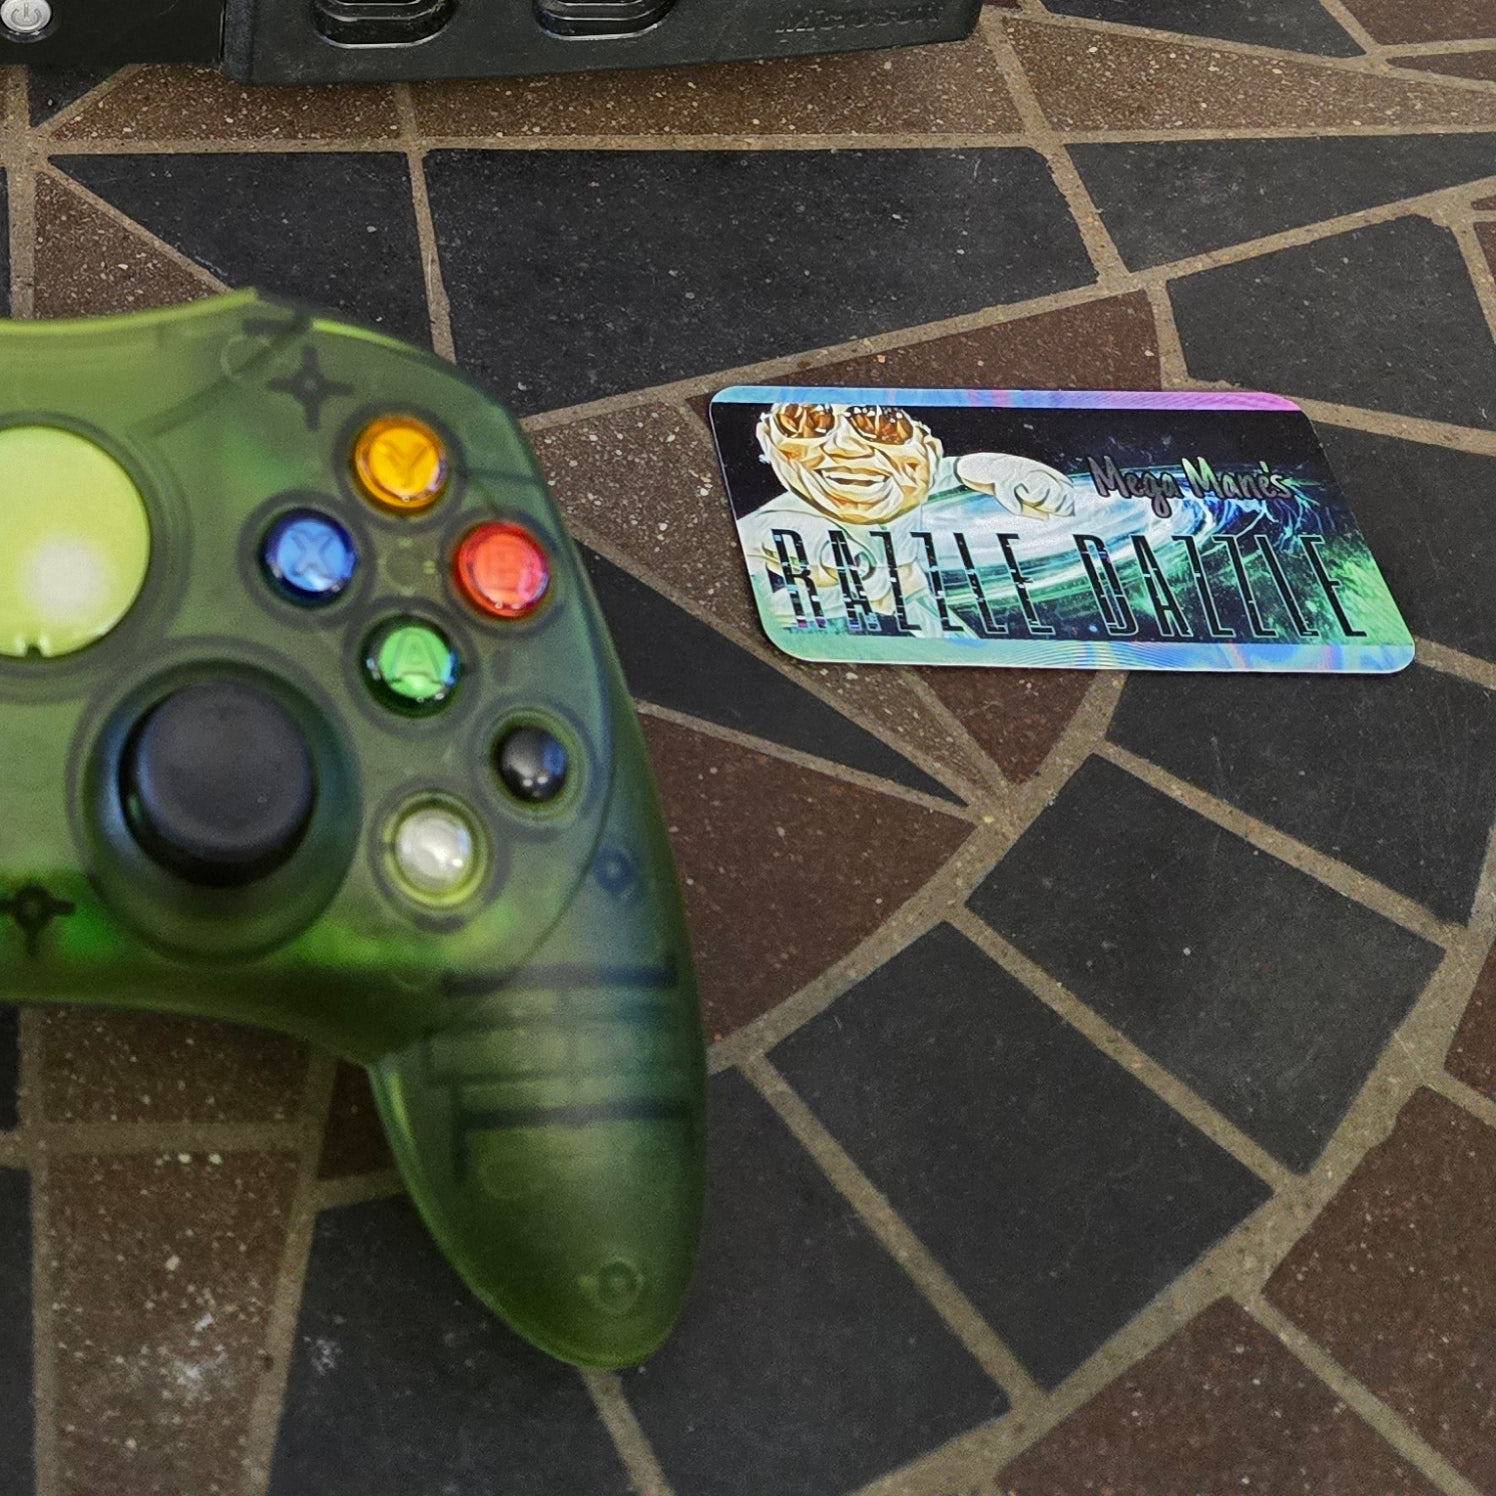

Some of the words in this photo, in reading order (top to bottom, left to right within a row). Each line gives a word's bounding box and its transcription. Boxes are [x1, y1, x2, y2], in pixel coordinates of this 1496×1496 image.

[379, 439, 430, 482] Y
[1088, 456, 1182, 518] Mega
[290, 530, 338, 578] X
[770, 528, 1056, 639] RAZZLE
[1073, 532, 1369, 640] DAZZLE
[390, 630, 445, 684] A
